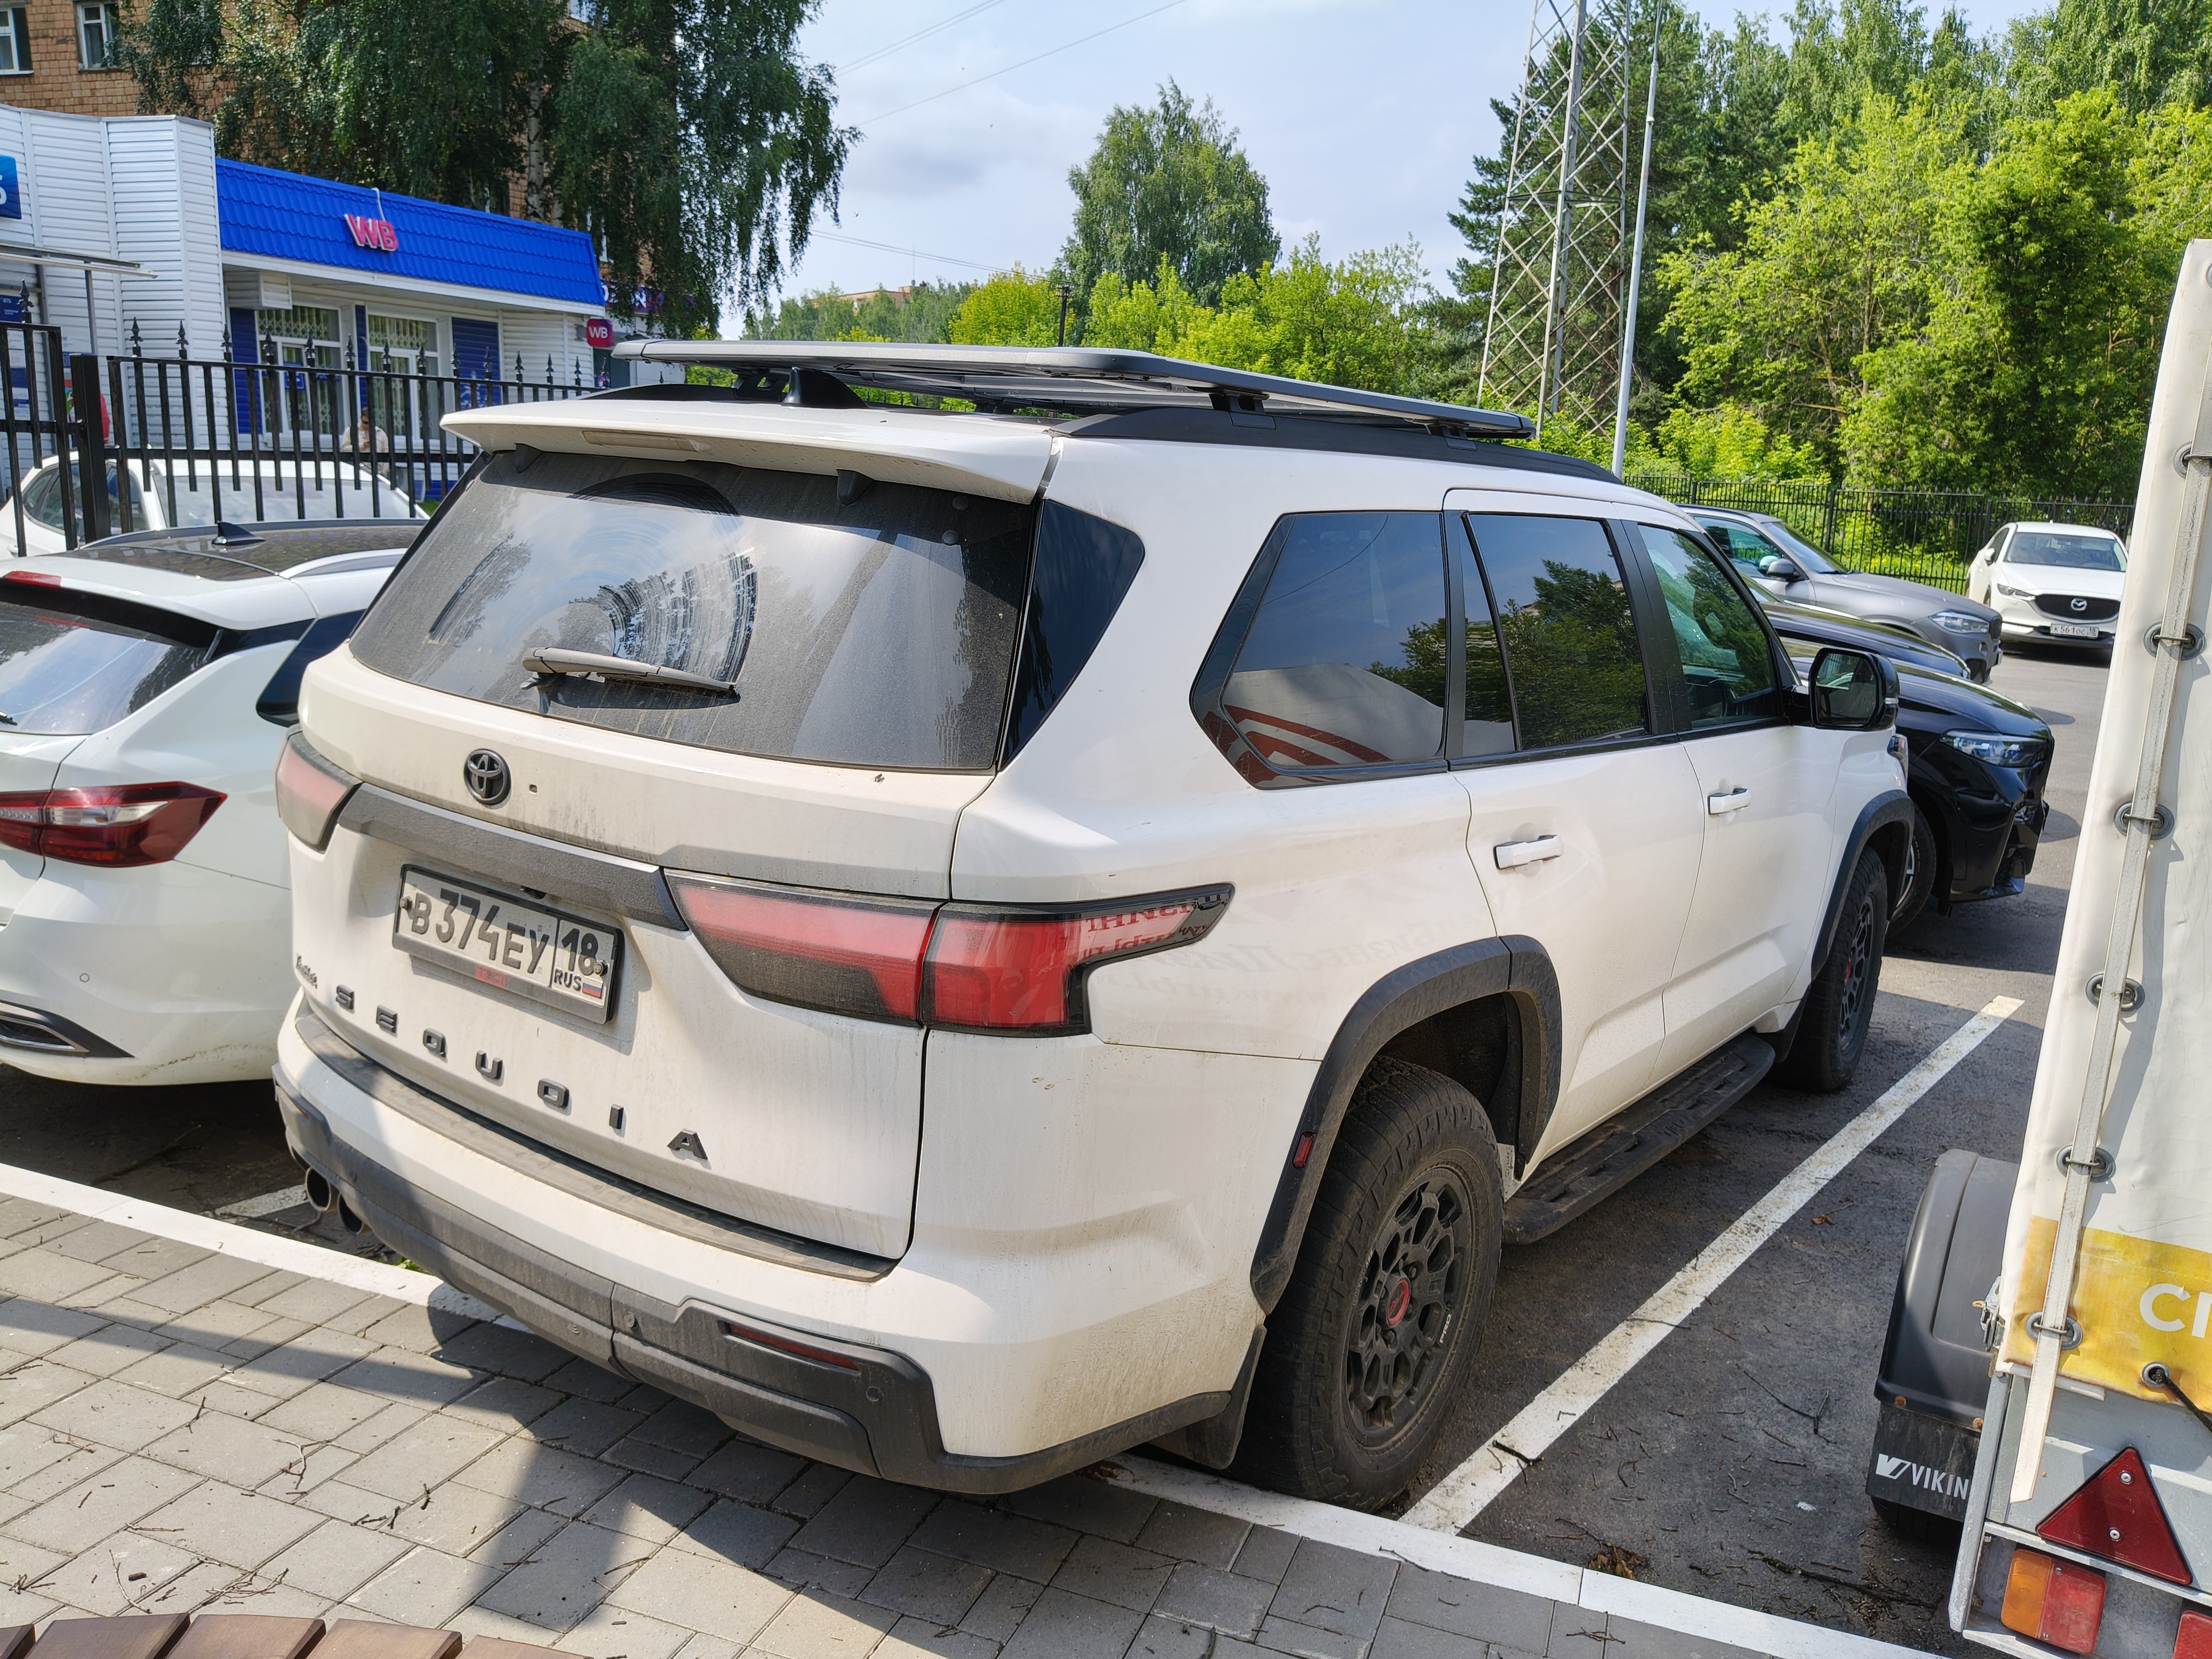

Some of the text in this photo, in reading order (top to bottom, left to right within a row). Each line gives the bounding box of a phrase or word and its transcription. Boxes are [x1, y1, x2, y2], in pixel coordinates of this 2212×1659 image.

[344, 213, 399, 251] WB
[588, 326, 608, 339] WB
[411, 888, 598, 976] В374ЕУ 18
[554, 968, 581, 992] RUS
[335, 984, 709, 1160] SEQUOIA
